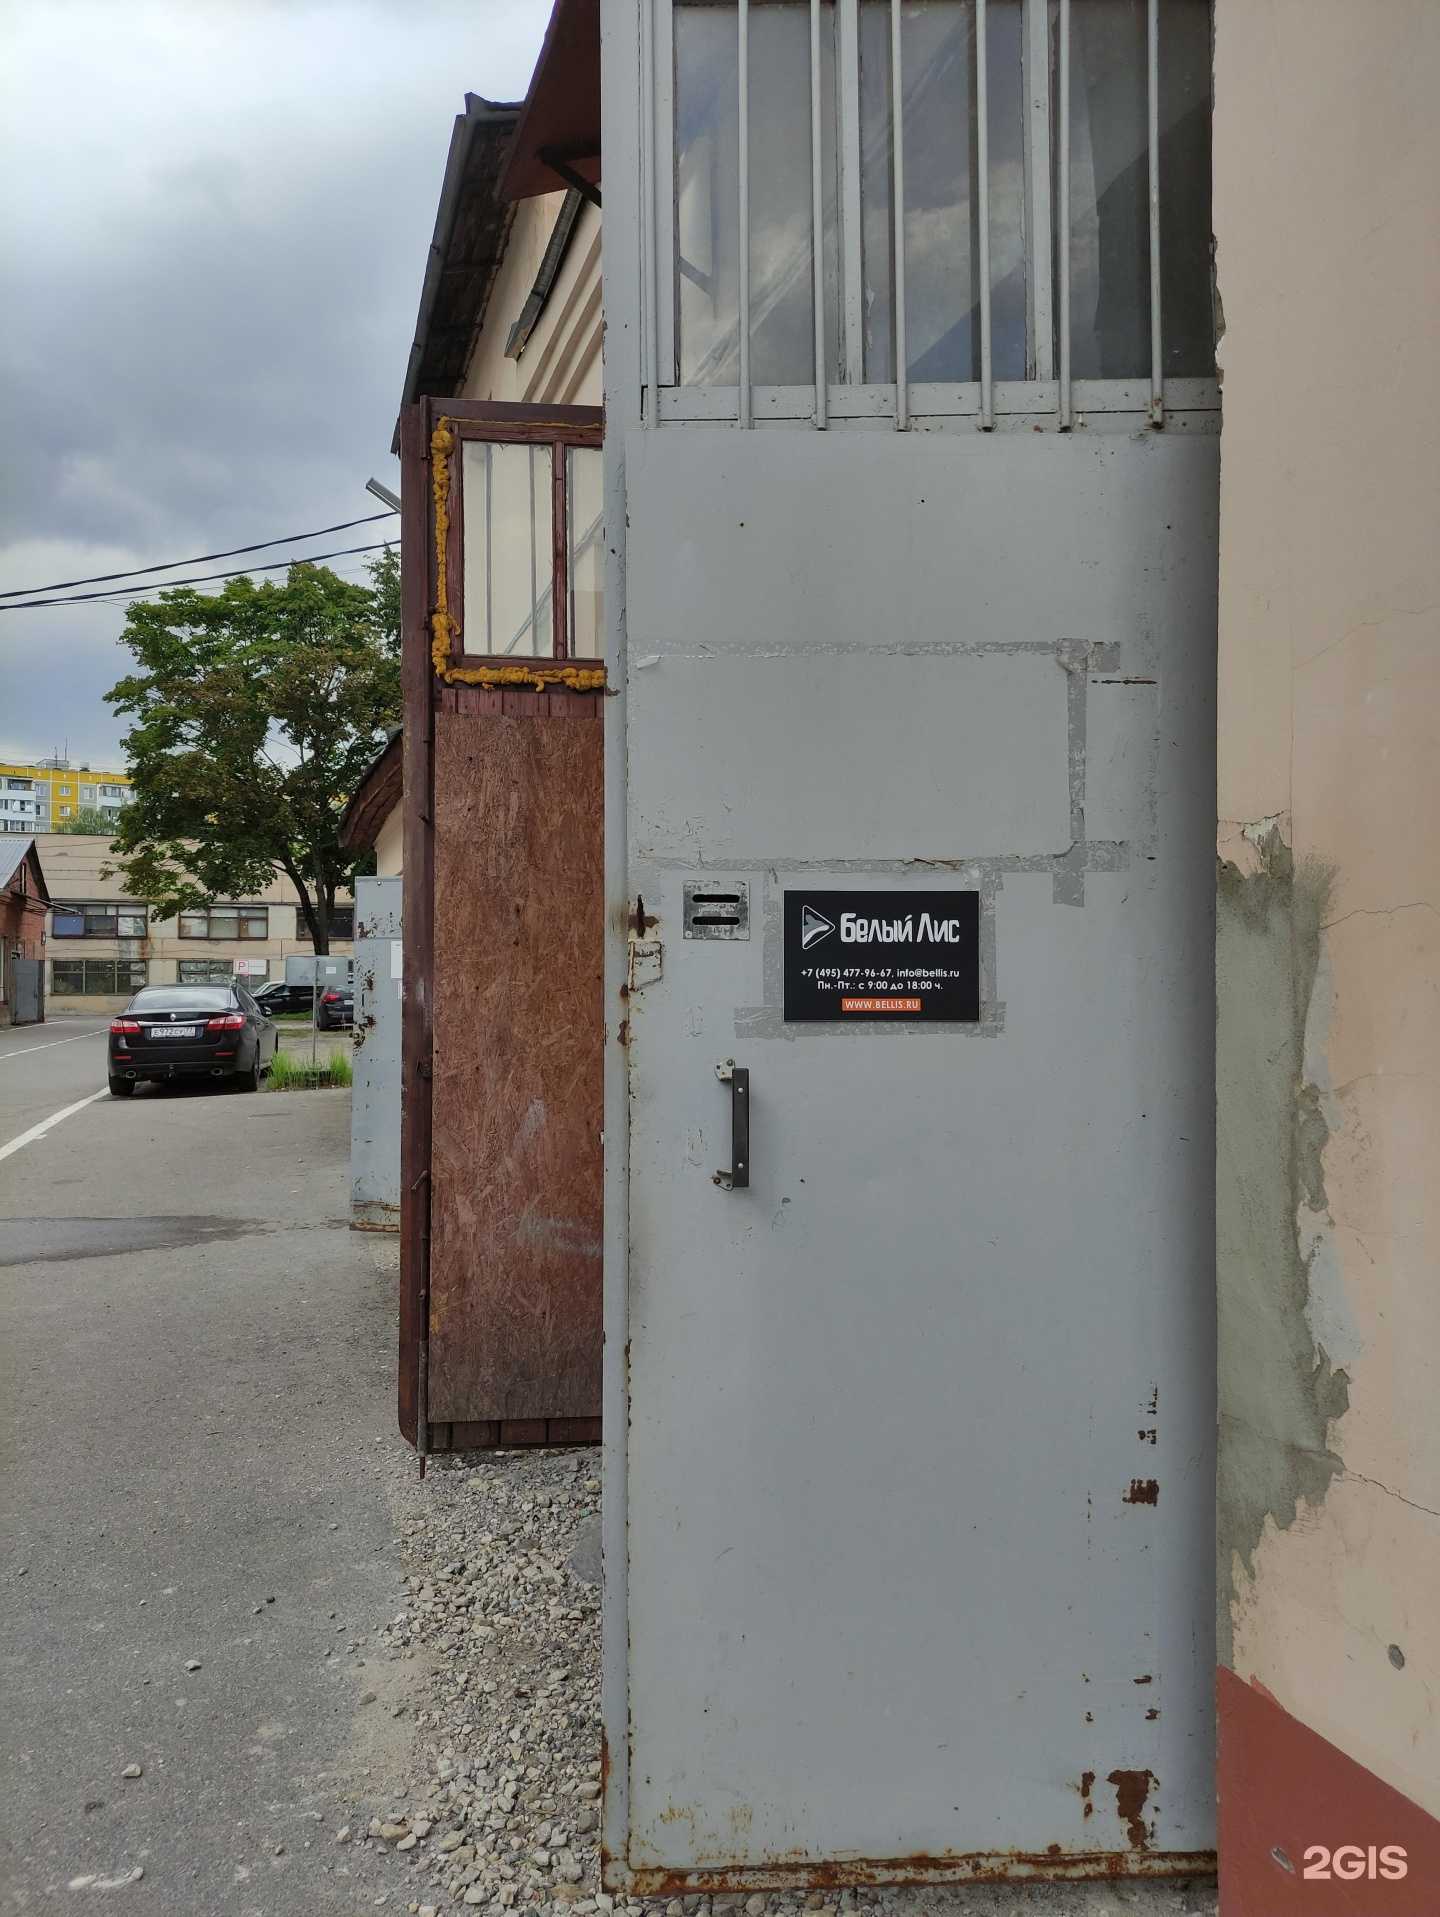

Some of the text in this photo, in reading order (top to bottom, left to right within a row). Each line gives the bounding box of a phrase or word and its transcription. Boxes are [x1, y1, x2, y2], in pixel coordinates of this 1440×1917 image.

[840, 912, 960, 943] Белый Лис
[801, 968, 960, 979] +7 (495) 477-96-67, info@bellis.ru
[867, 980, 888, 990] 9:00
[890, 983, 904, 991] до
[907, 980, 932, 990] 18:00
[934, 982, 943, 990] ч.
[845, 1000, 919, 1010] WWW.BELLIS.RU
